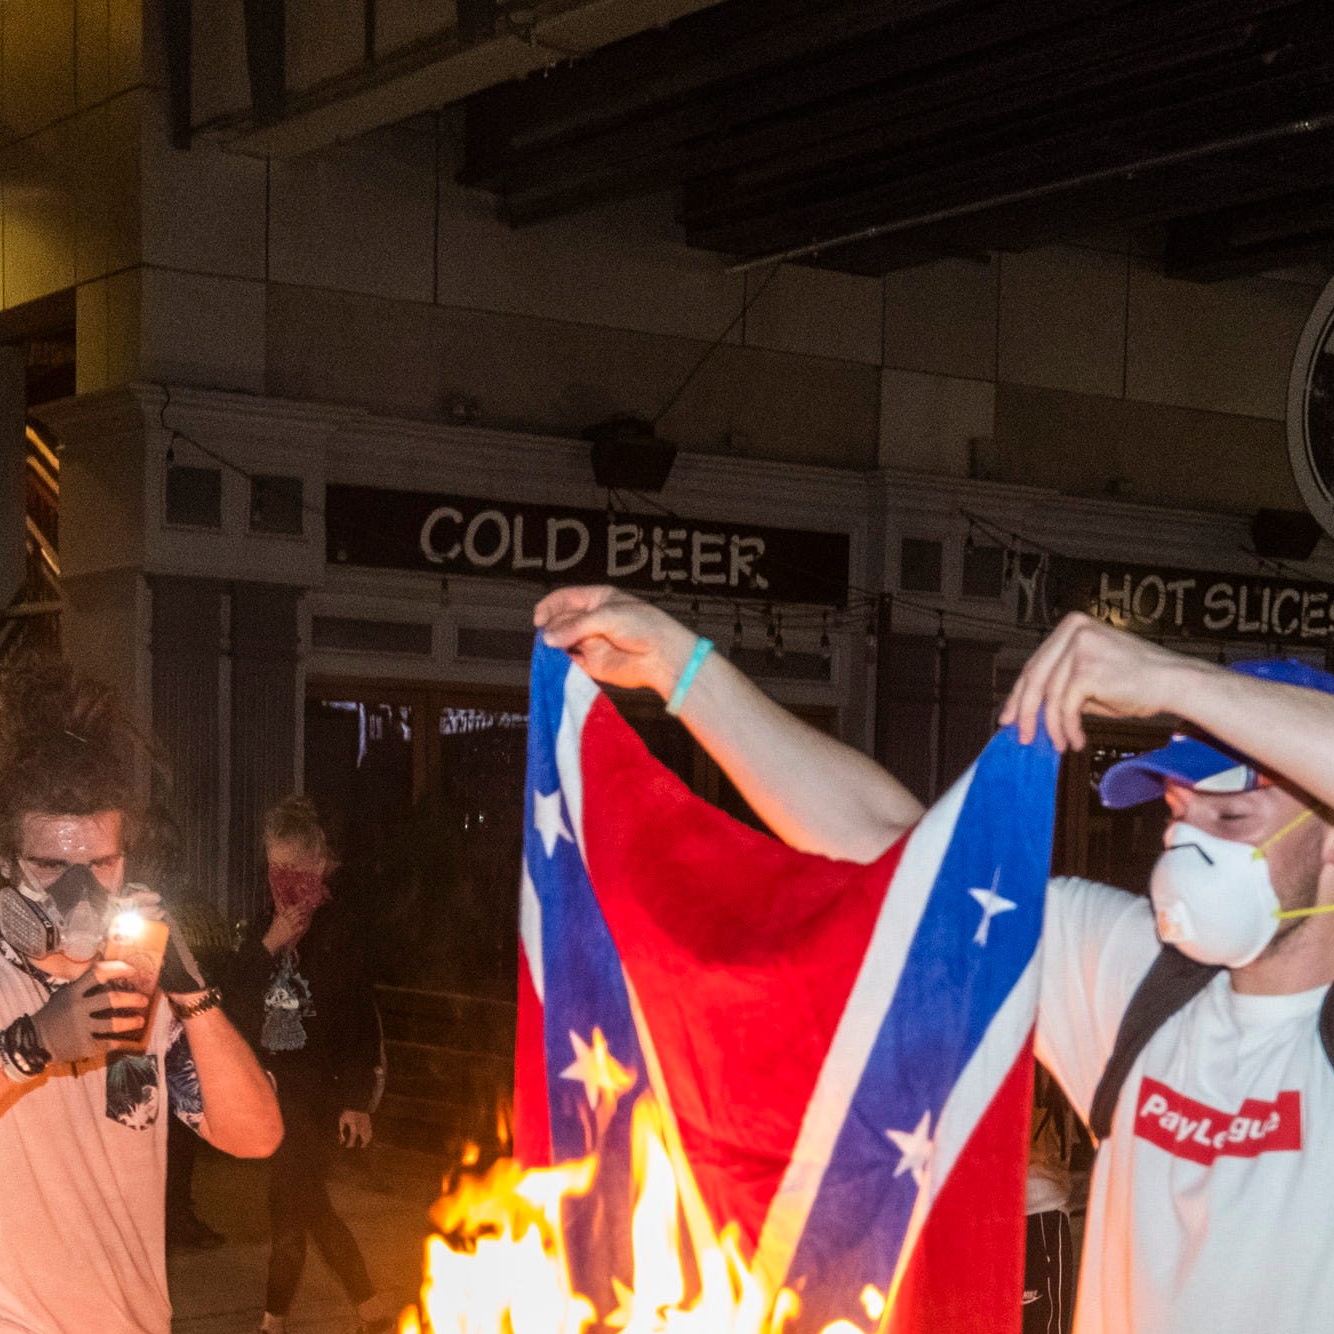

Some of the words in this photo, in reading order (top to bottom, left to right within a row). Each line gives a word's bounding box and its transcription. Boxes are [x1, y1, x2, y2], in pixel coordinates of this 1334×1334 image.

[420, 506, 590, 572] COLD
[605, 522, 770, 589] BEER
[1098, 571, 1196, 627] HOT
